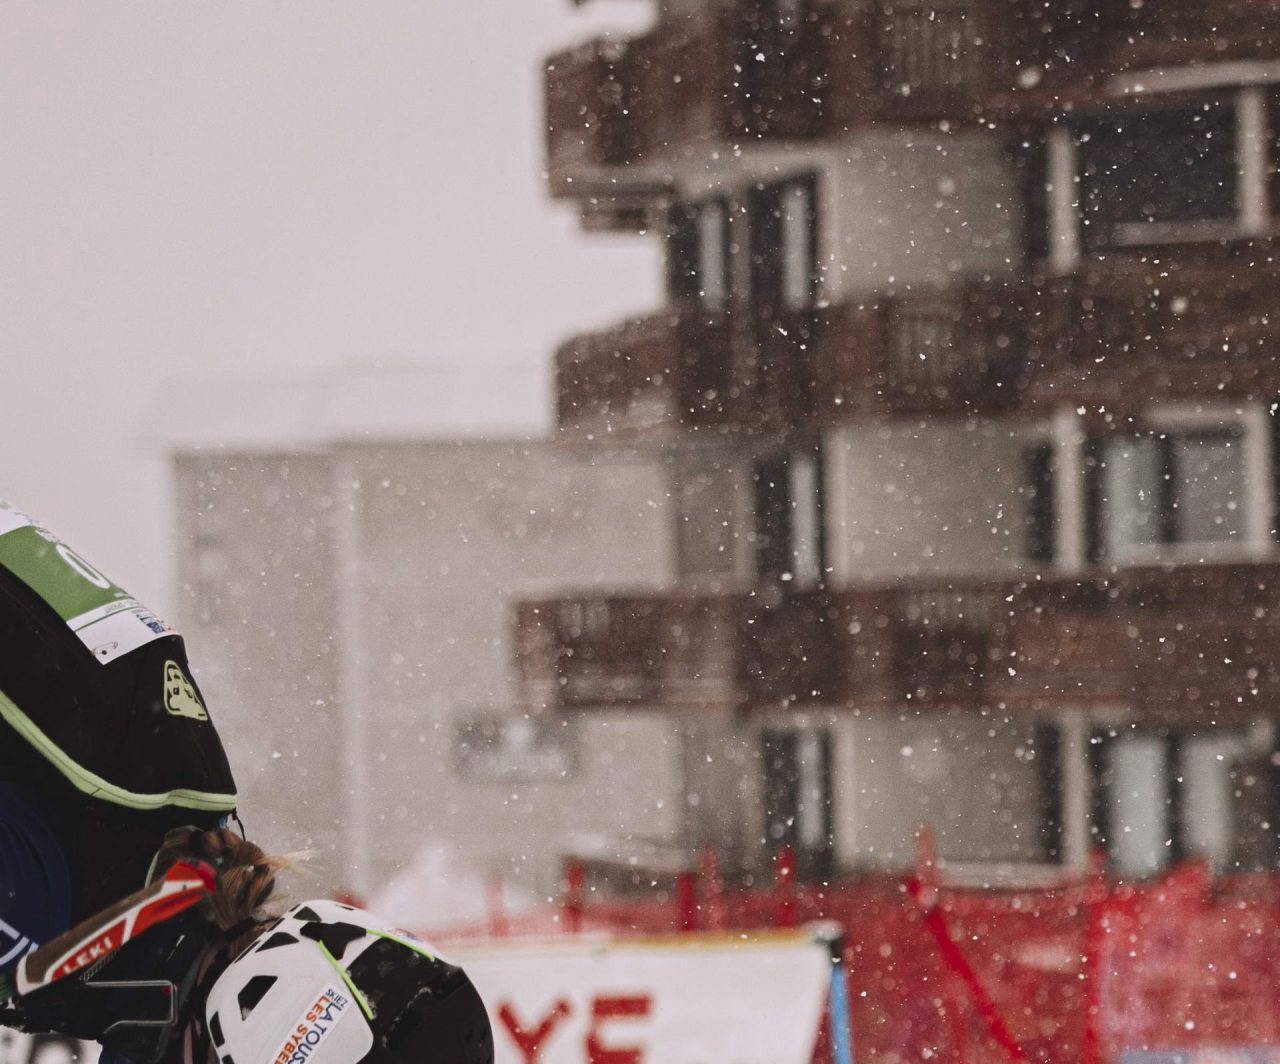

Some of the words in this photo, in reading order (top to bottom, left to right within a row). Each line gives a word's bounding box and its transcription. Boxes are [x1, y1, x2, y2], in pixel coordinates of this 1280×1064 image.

[64, 935, 113, 975] LEKI
[306, 995, 331, 1023] LES
[319, 1003, 343, 1022] LA
